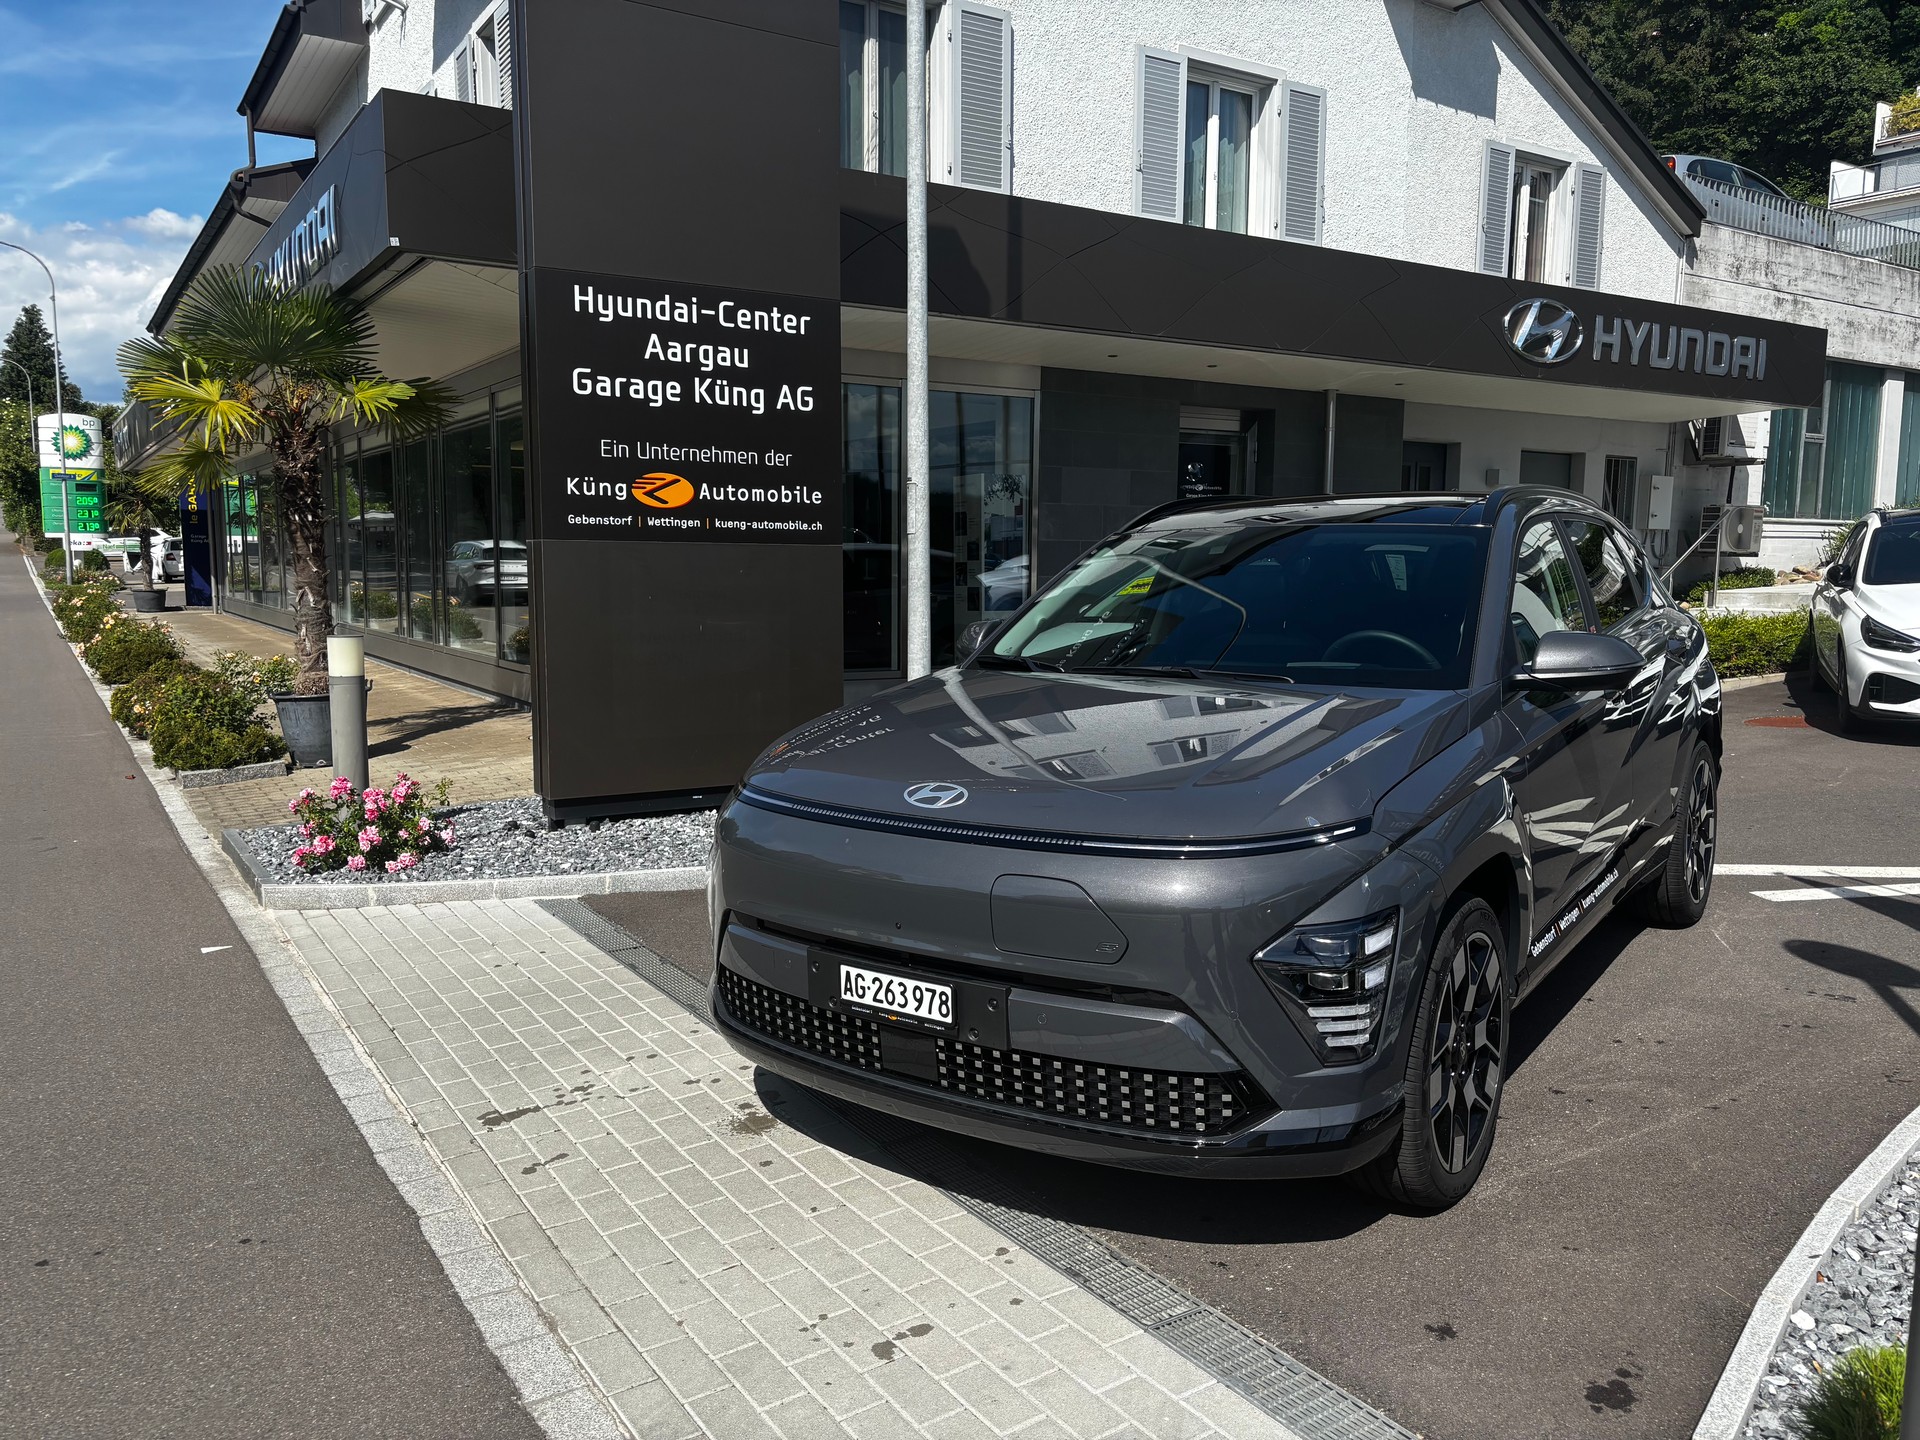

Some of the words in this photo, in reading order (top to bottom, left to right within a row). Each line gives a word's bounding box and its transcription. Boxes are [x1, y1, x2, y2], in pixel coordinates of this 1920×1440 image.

[574, 285, 810, 335] Hyundai-Center
[644, 334, 748, 371] Aargau
[1592, 314, 1766, 381] HYUNDAI
[573, 368, 680, 407] Garage
[695, 377, 764, 414] Küng
[777, 385, 813, 411] AG
[82, 418, 95, 428] bp
[601, 440, 628, 458] Ein
[638, 442, 757, 464] Unternehmen
[765, 449, 792, 466] der
[567, 477, 626, 500] Küng
[700, 483, 821, 504] Automobile
[568, 515, 632, 525] Gebenstorf
[648, 517, 700, 528] Wettingen
[716, 518, 822, 530] kueng-automobile.ch
[1531, 926, 1556, 957] Gebenstorf
[1558, 908, 1580, 931] Wettingen
